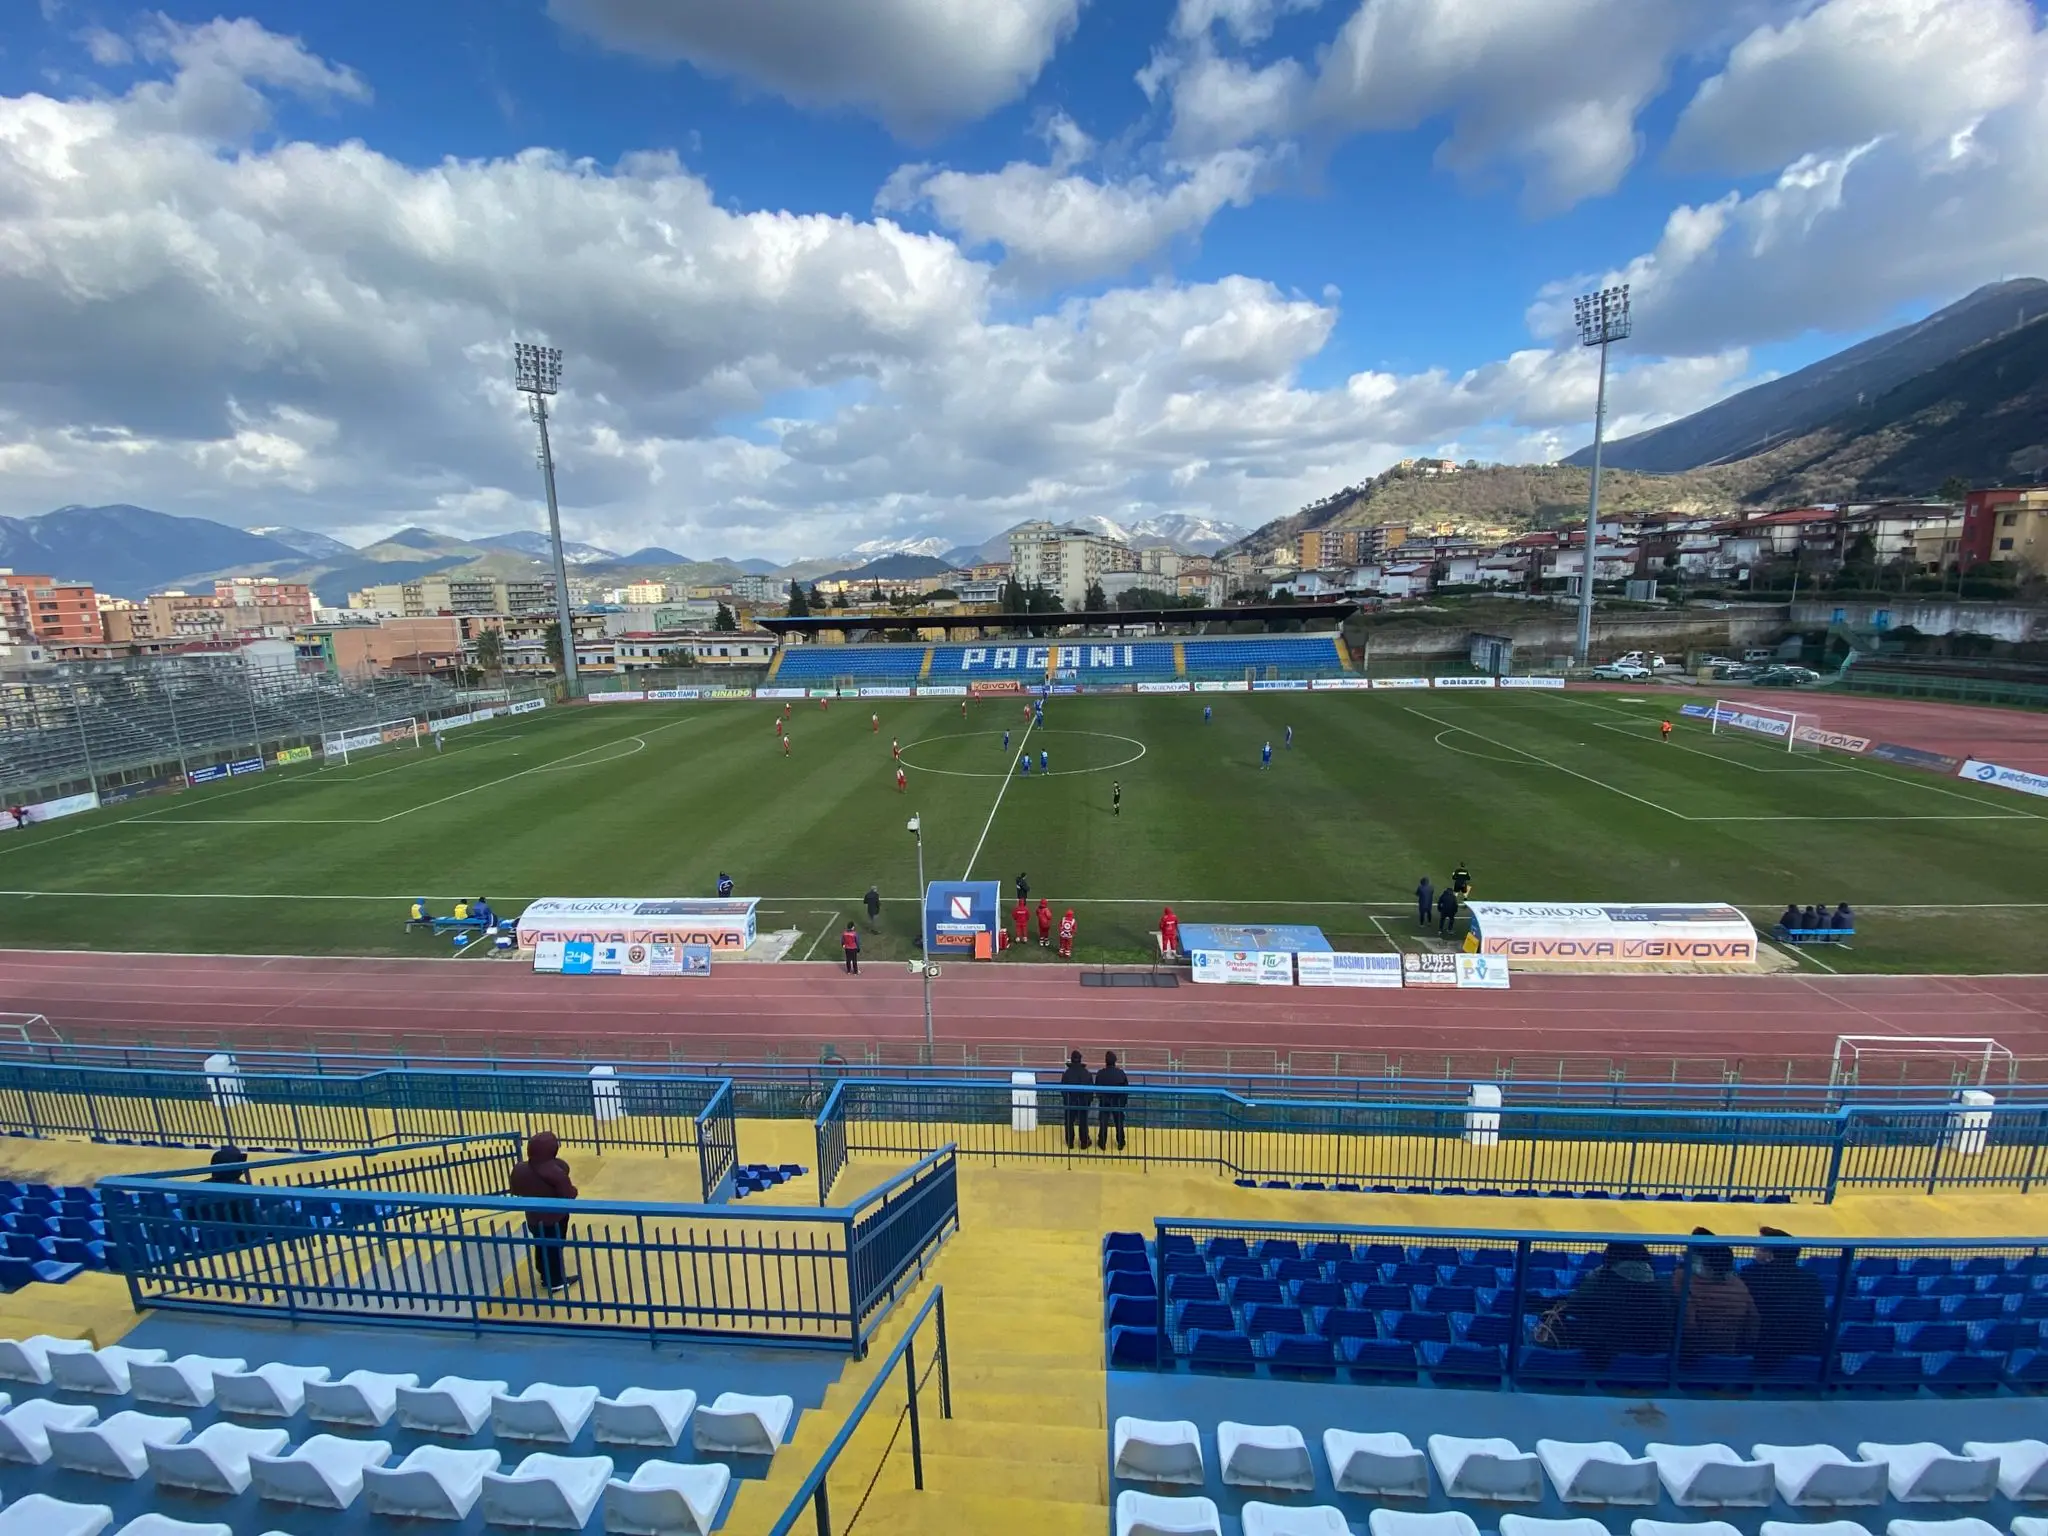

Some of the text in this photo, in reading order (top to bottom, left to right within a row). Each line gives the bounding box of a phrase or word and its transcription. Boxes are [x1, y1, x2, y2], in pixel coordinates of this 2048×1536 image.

[961, 647, 1133, 670] PAGANI
[712, 690, 750, 698] RINALDO
[1808, 731, 1864, 750] GIVOVA
[564, 902, 638, 911] AGROVO
[1518, 907, 1603, 917] AGROVO
[652, 933, 740, 945] GIVOVA
[1511, 941, 1614, 956] GIVOVA
[1646, 942, 1750, 957] GIVOVA
[1333, 955, 1365, 970] MASSIMO
[1421, 954, 1455, 963] STREET
